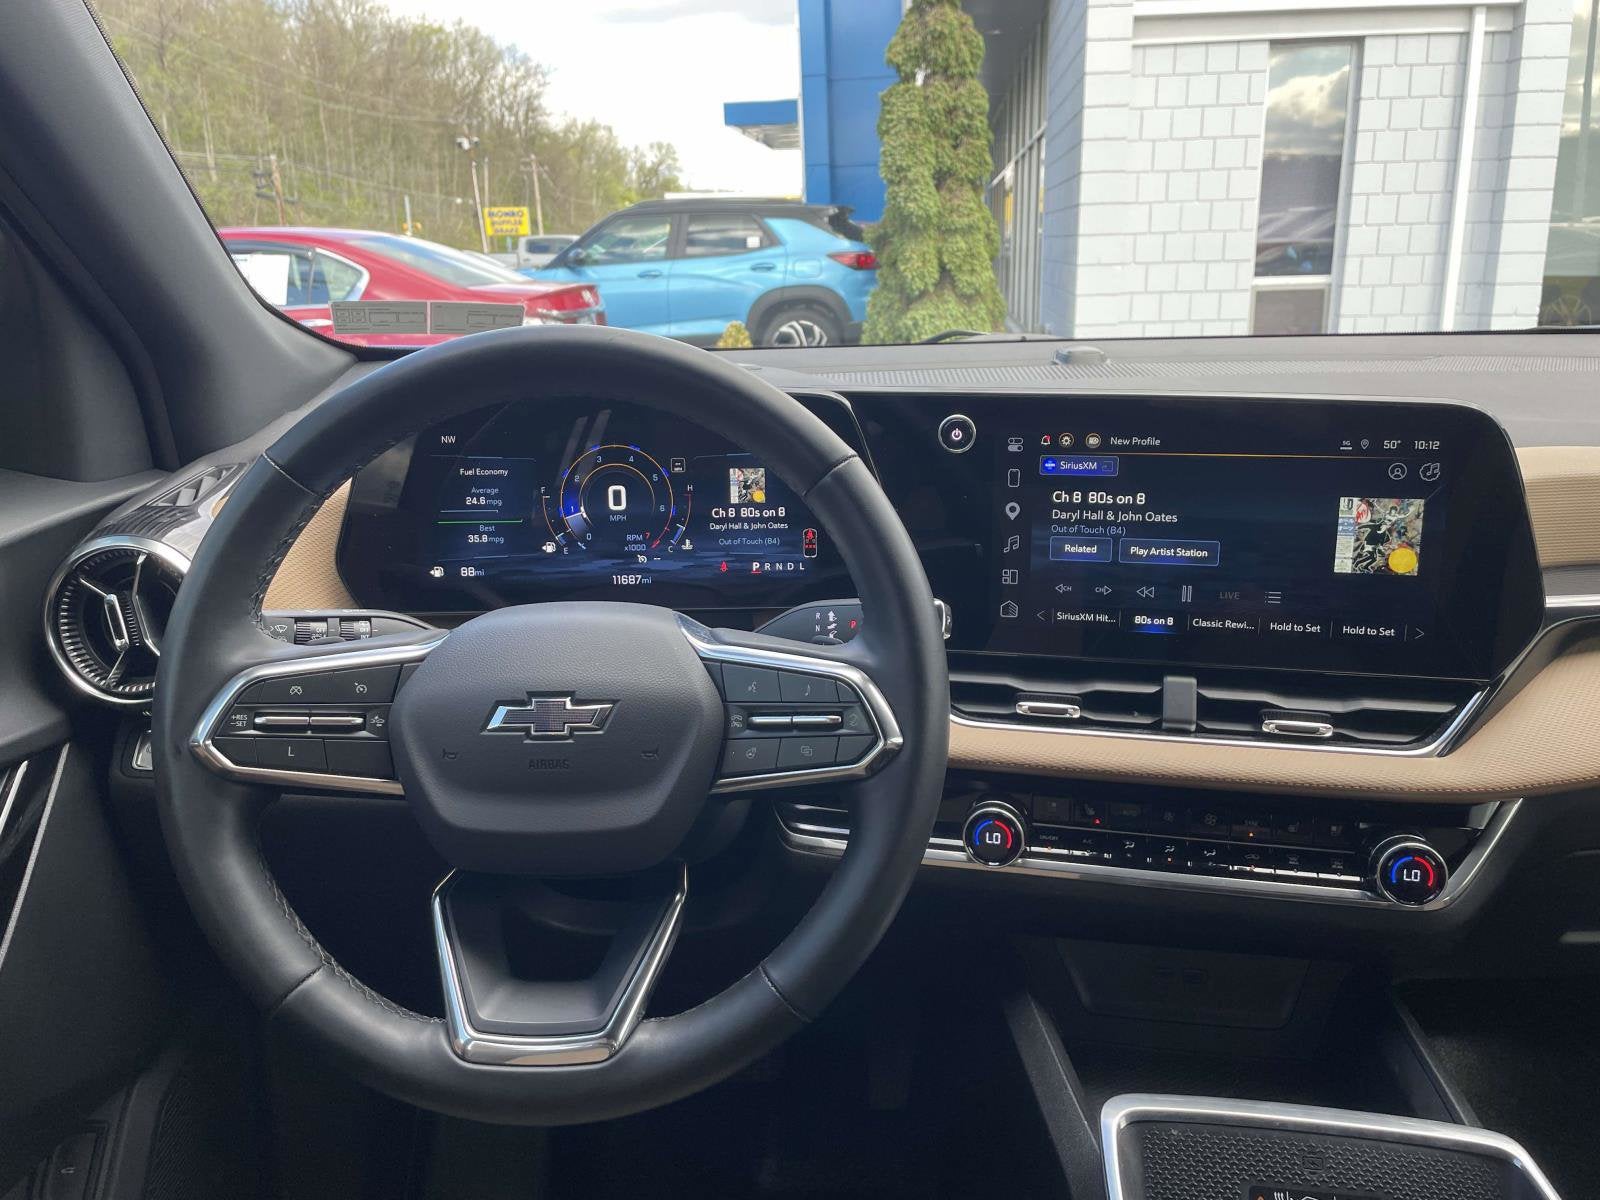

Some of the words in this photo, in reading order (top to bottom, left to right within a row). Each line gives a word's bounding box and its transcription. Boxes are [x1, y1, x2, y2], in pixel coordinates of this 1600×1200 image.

[441, 435, 456, 444] NW
[1110, 437, 1131, 446] New
[1132, 437, 1161, 446] Profile
[1414, 440, 1440, 450] 10:12
[596, 455, 602, 463] 3
[629, 455, 634, 463] 4
[1060, 461, 1097, 470] SiriusXM
[459, 468, 475, 476] Fuel
[476, 468, 509, 477] Economy
[471, 486, 499, 495] Average
[608, 485, 627, 511] 0
[1053, 491, 1070, 503] Ch
[1073, 492, 1081, 503] 8
[1088, 492, 1113, 504] 80s
[1116, 495, 1133, 504] on
[1136, 493, 1146, 505] 8
[712, 508, 727, 518] Ch
[728, 508, 736, 518] 8
[740, 508, 761, 518] 80s
[763, 509, 776, 518] on
[778, 507, 786, 517] 8
[1052, 510, 1080, 523] Daryl
[1083, 510, 1103, 521] Hall
[1106, 511, 1115, 521] &
[1117, 511, 1142, 523] John
[1145, 512, 1178, 523] Oates
[609, 514, 627, 522] MPH
[479, 524, 495, 532] Best
[709, 522, 727, 532] Daryl
[728, 522, 742, 530] Hall
[743, 522, 749, 530] &
[750, 522, 767, 531] John
[768, 522, 788, 530] Oates
[1051, 525, 1068, 533] Out
[1068, 525, 1079, 533] of
[1080, 525, 1105, 534] Touch
[1106, 525, 1126, 536] (84)
[626, 534, 643, 542] RPM
[732, 537, 740, 545] of
[740, 537, 763, 545] Touch
[624, 543, 646, 552] x1000
[1064, 544, 1097, 554] Related
[1130, 546, 1148, 558] Play
[1150, 547, 1175, 557] Artist
[1176, 548, 1208, 558] Station
[752, 562, 760, 571] P
[764, 562, 771, 571] R
[775, 562, 783, 571] N
[787, 562, 794, 571] D
[799, 562, 805, 571] L
[1219, 591, 1240, 600] LIVE
[1057, 612, 1094, 622] SiriusXM
[1134, 615, 1152, 625] 80s
[1153, 618, 1166, 626] on
[1167, 617, 1174, 626] 8
[815, 624, 821, 632] N
[1192, 618, 1223, 628] Classic
[1270, 622, 1292, 632] Hold
[1294, 623, 1303, 632] to
[1305, 623, 1321, 633] Set
[1342, 625, 1365, 635] Hold
[1367, 627, 1377, 636] to
[1379, 627, 1395, 636] Set
[288, 746, 294, 757] L
[528, 759, 570, 770] AIRBAG
